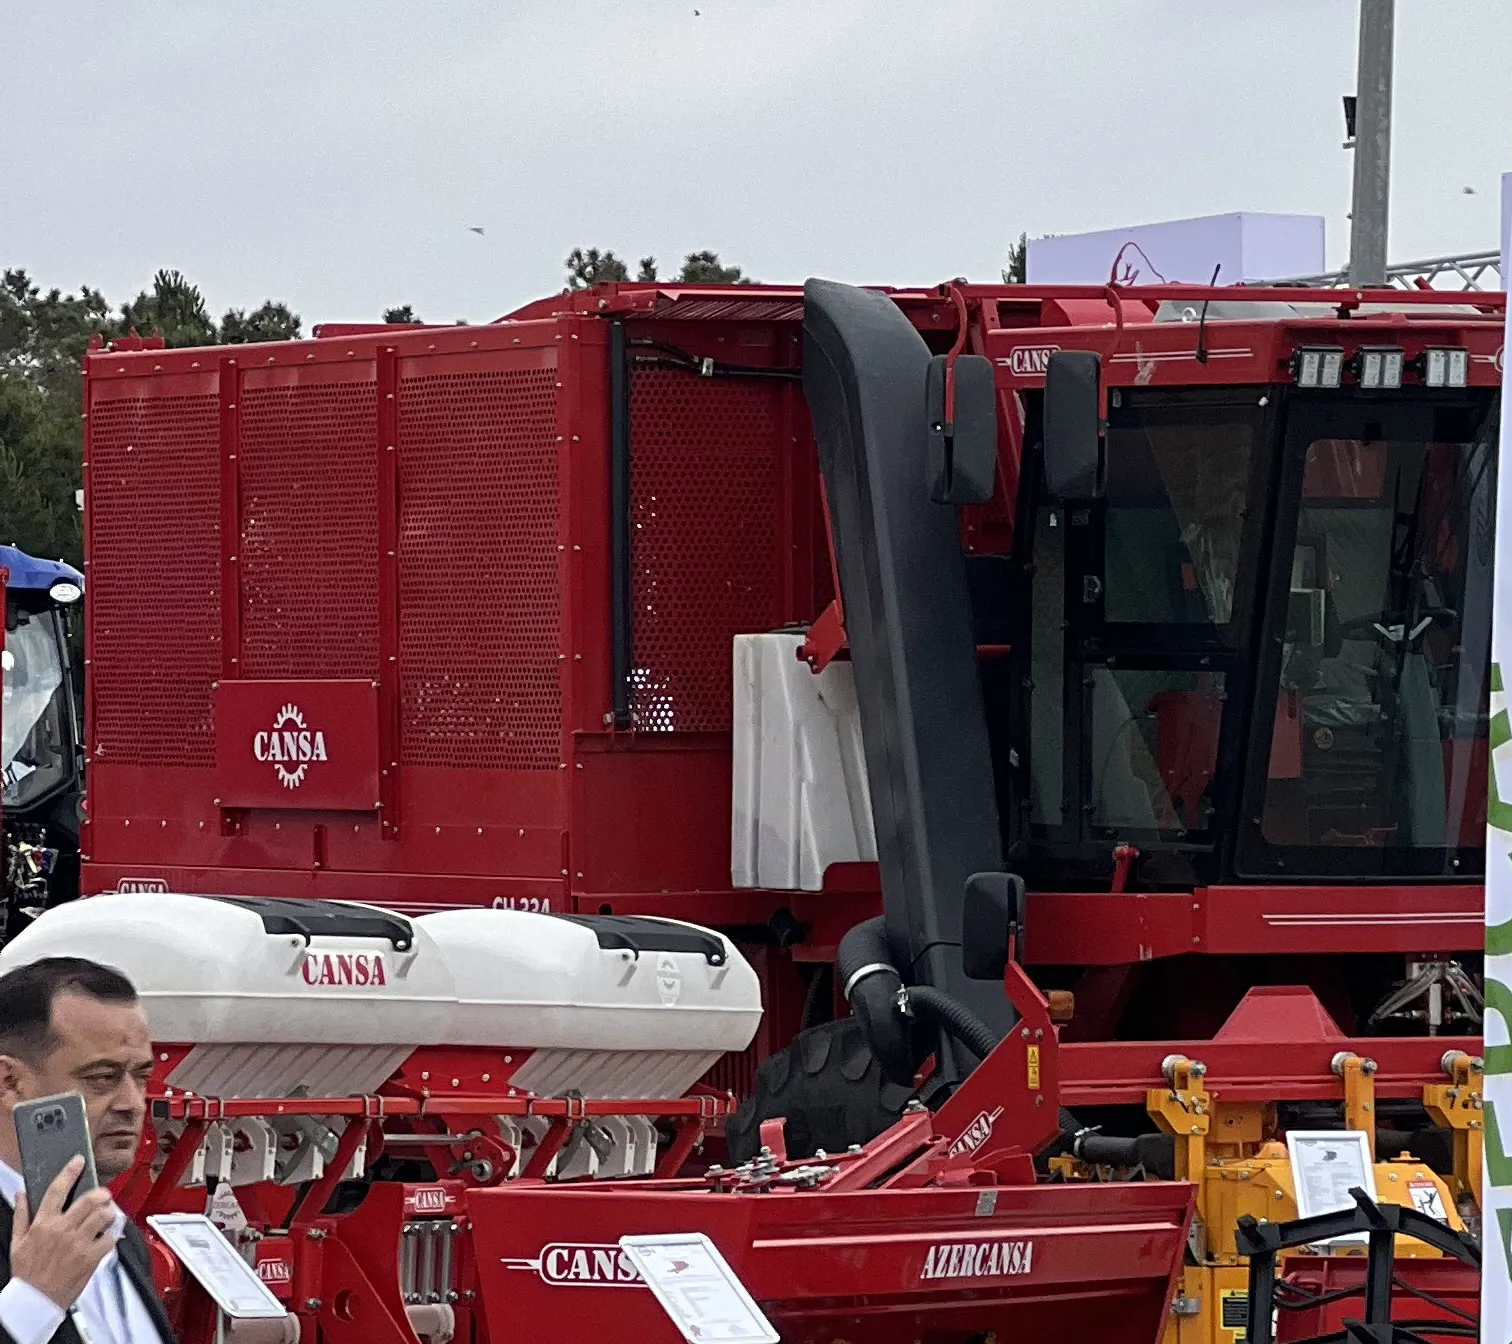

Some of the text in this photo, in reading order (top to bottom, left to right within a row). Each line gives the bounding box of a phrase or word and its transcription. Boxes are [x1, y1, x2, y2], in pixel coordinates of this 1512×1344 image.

[1013, 349, 1058, 372] CANS
[253, 731, 328, 762] CANSA
[302, 954, 386, 986] CANSA
[416, 1191, 444, 1209] CANSA
[547, 1248, 646, 1282] CANS
[920, 1241, 1033, 1280] AZERCANSA
